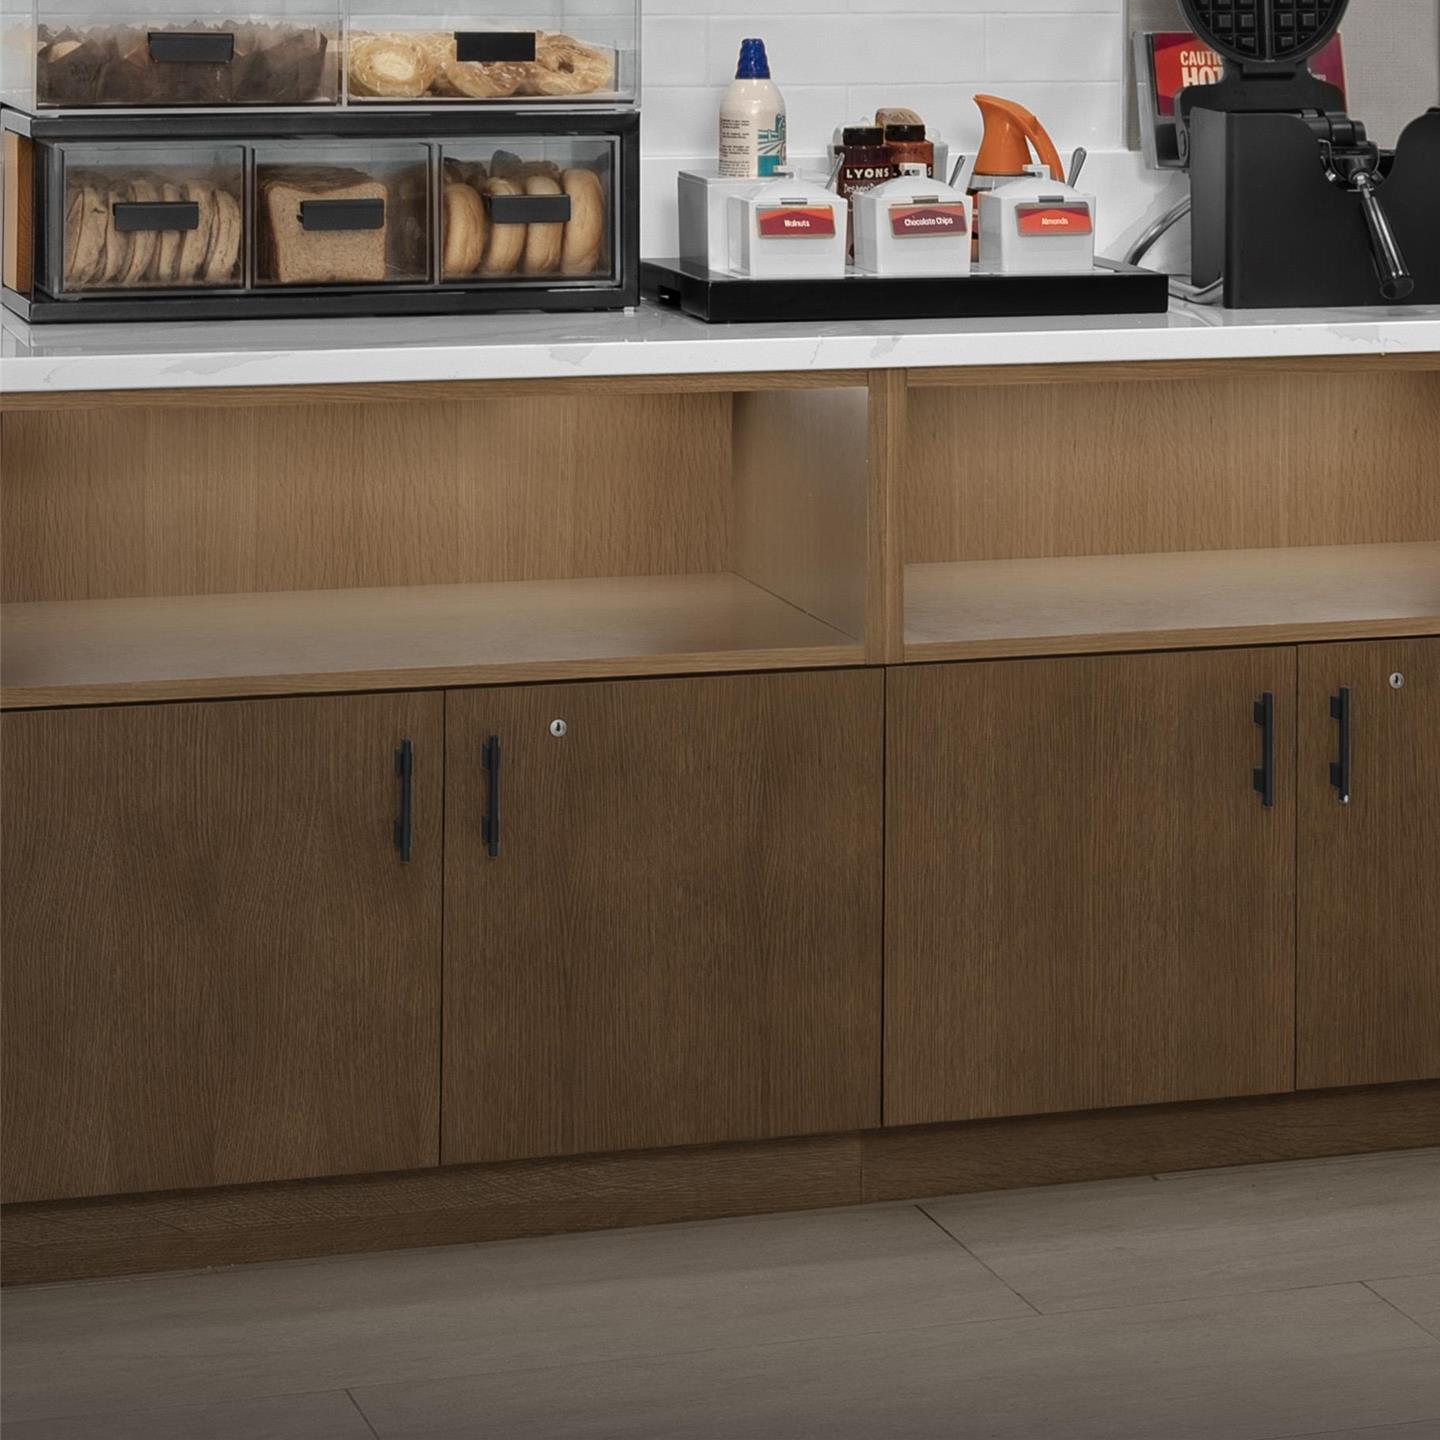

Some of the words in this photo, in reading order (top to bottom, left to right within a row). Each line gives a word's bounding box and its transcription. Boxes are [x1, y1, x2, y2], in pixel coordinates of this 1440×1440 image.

[1179, 50, 1223, 66] CAUTI
[846, 167, 890, 180] LYONS
[904, 217, 936, 227] Chocolate
[936, 216, 954, 226] Chips
[1041, 217, 1069, 225] Almonds
